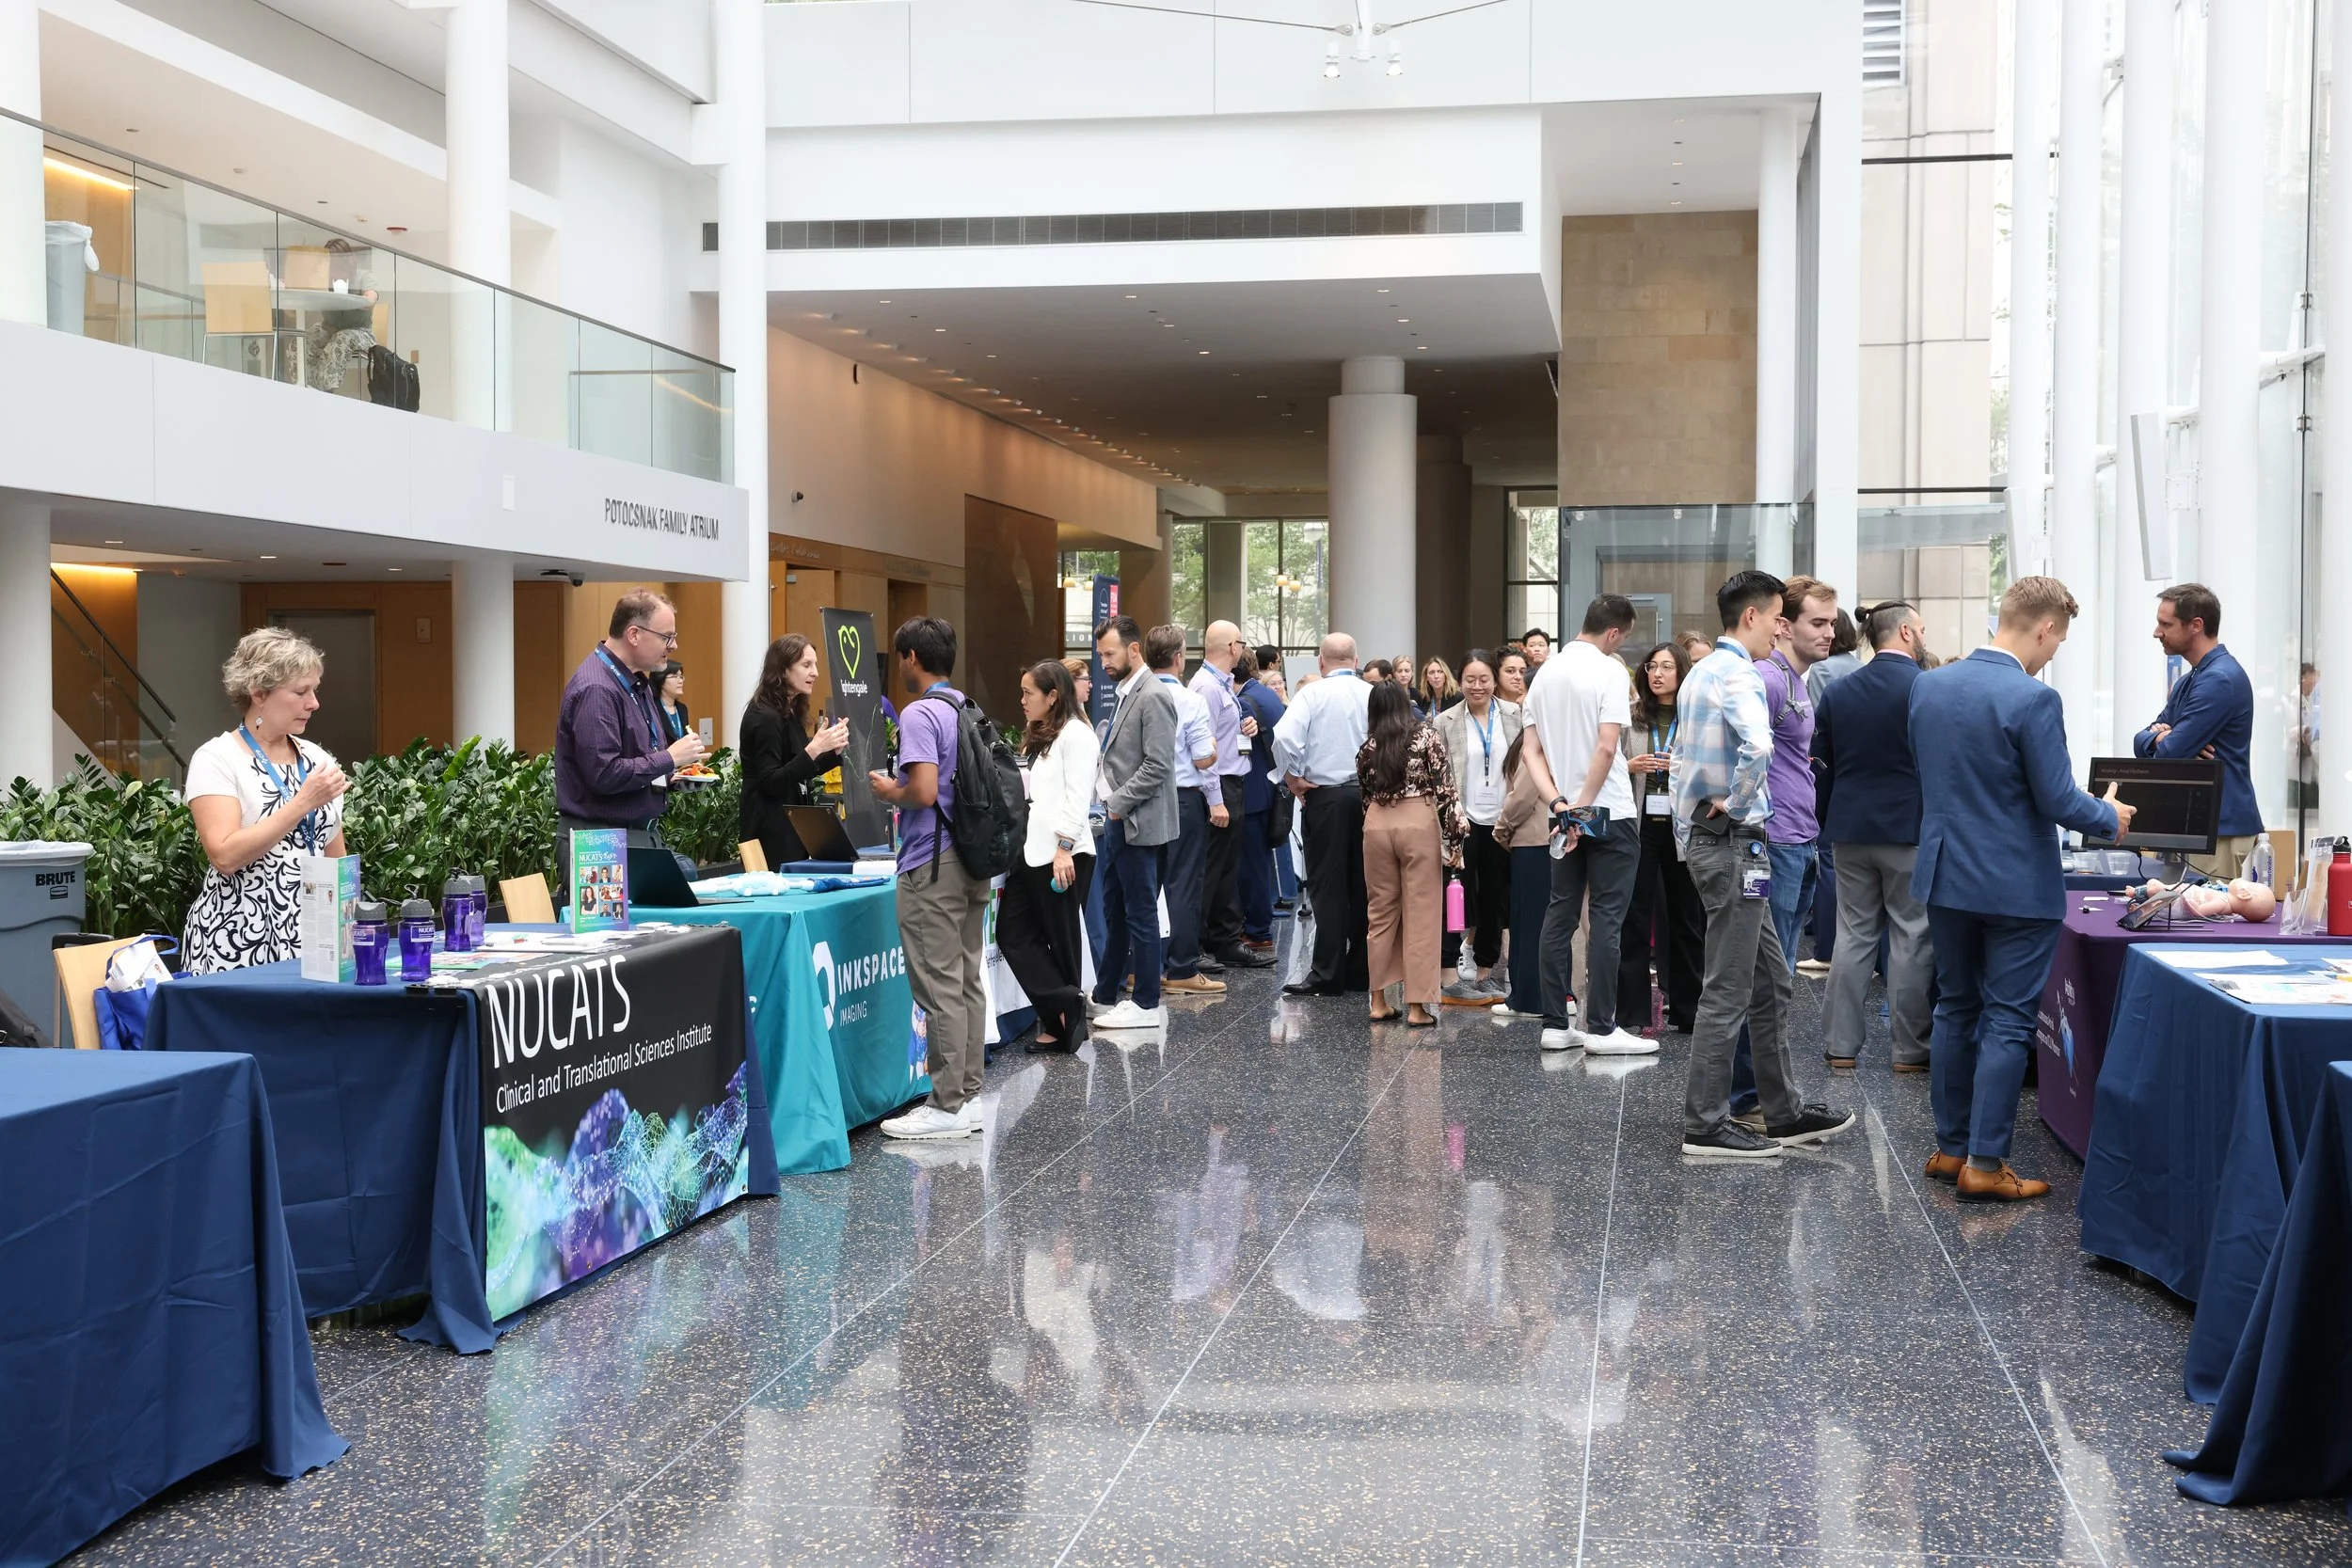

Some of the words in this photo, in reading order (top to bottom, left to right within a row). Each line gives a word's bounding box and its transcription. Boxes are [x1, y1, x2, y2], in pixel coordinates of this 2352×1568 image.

[604, 498, 658, 531] POTOCSNAK
[659, 508, 688, 535] FAMILY
[689, 514, 719, 541] ATRIUM
[36, 871, 75, 886] BRUTE
[579, 853, 602, 863] NUCATS
[837, 945, 906, 995] INKSPACE
[484, 954, 631, 1069] NUCATS
[839, 1000, 867, 1027] IMAGING
[496, 1073, 534, 1114] Clinical
[537, 1066, 561, 1099] and
[564, 1043, 632, 1089] Translational
[634, 1035, 675, 1067] Sciences
[676, 1022, 712, 1053] Institute
